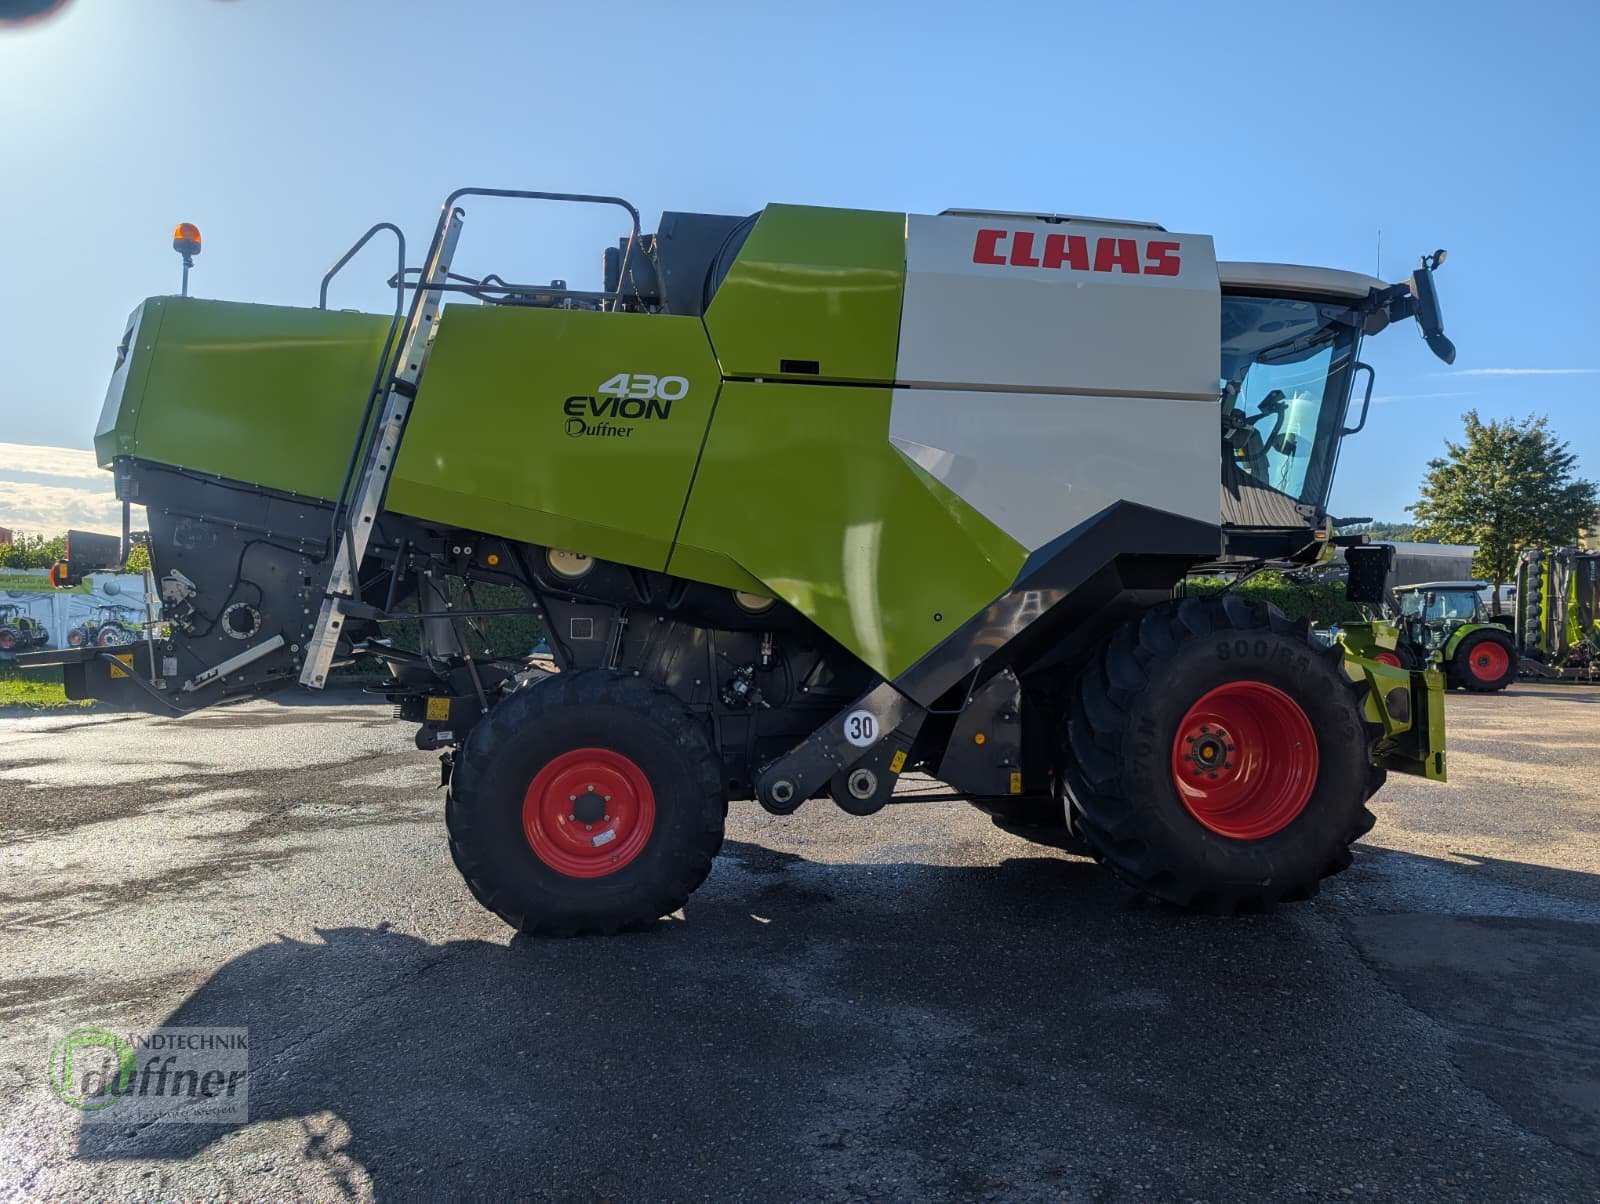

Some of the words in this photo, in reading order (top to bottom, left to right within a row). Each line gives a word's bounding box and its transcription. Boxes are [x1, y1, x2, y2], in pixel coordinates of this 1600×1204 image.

[972, 229, 1181, 277] CLAAS
[598, 373, 689, 401] 430
[563, 396, 673, 420] EVION
[565, 417, 634, 438] Duffner
[850, 716, 873, 740] 30
